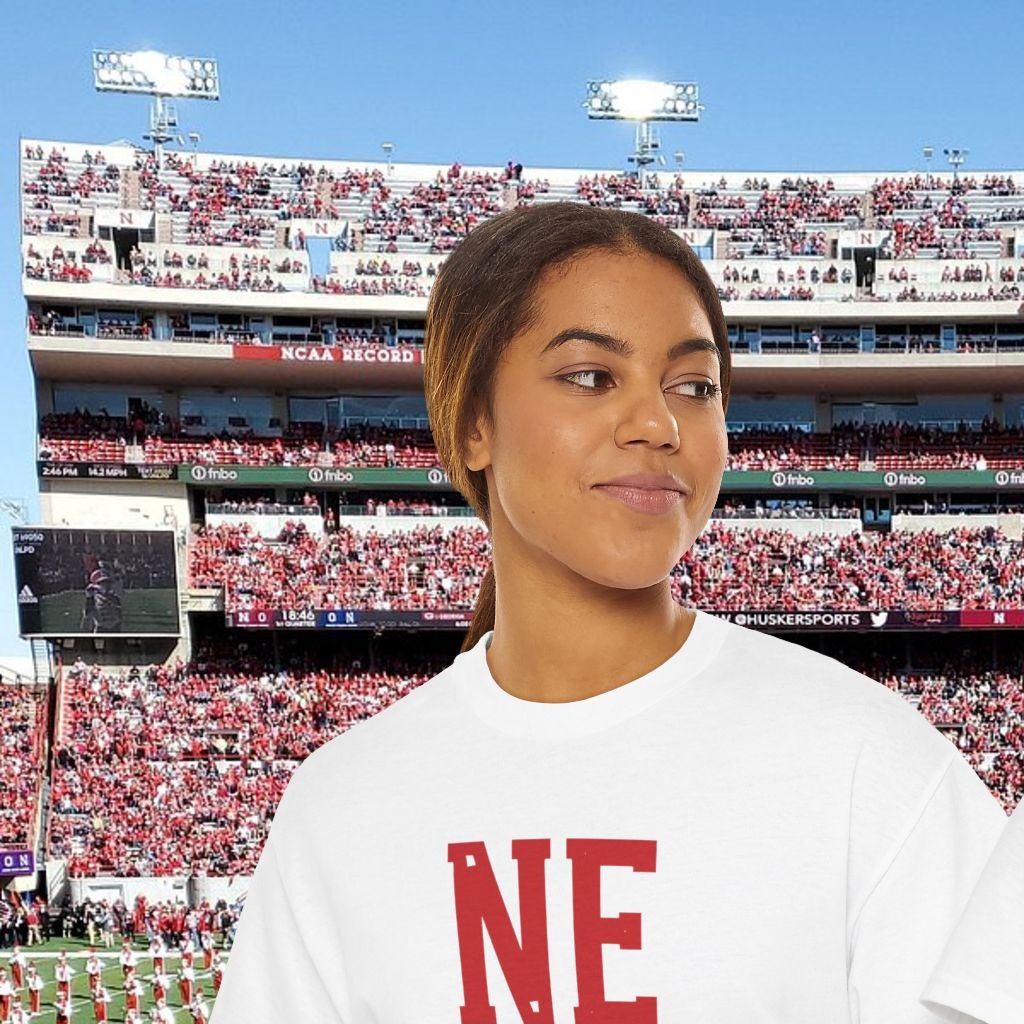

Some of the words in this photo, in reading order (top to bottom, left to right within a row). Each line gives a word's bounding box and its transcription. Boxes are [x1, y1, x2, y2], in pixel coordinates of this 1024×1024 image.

[281, 346, 334, 360] NCAA
[342, 348, 414, 363] RECORD
[209, 468, 238, 480] fnbo
[325, 469, 354, 481] fnbo
[787, 474, 814, 485] fnbo
[899, 474, 926, 485] fnbo
[282, 609, 315, 621] 18:46
[735, 613, 860, 625] @HUSKERSPORTS
